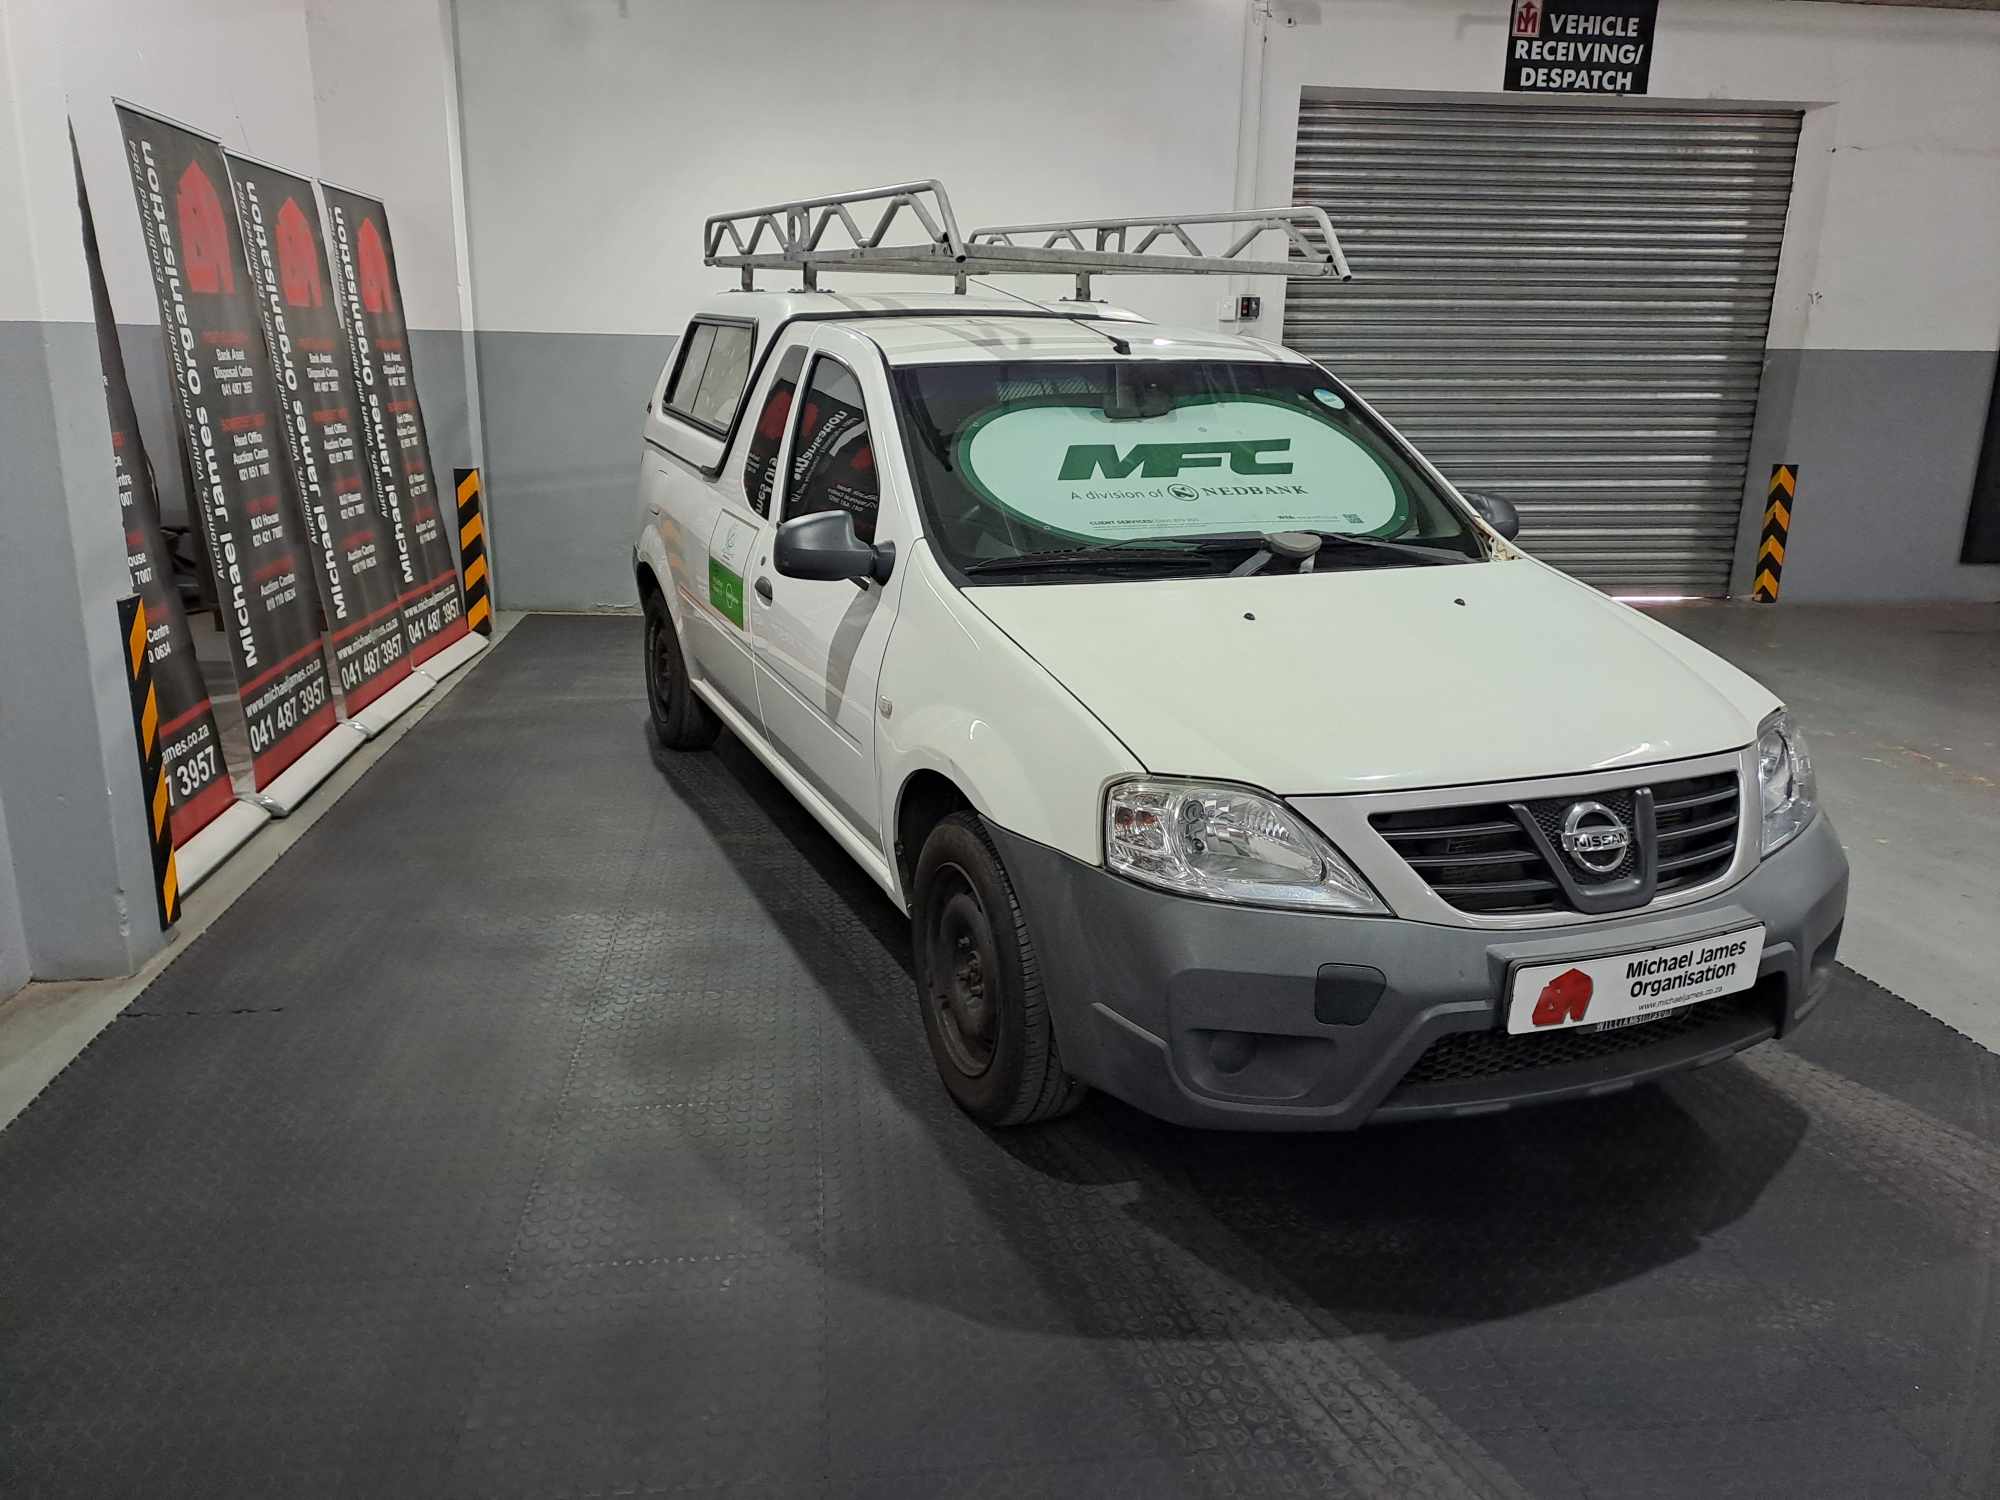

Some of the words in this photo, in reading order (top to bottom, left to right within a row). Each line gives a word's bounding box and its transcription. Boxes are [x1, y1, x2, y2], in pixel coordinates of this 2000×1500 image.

[1550, 14, 1640, 37] VEHICLE
[1514, 39, 1644, 65] RECEIVING/
[1520, 67, 1633, 91] DESPATCH
[128, 140, 144, 182] 1964
[138, 186, 164, 283] Established
[141, 140, 201, 395] Organisation
[246, 181, 298, 391] Organisation
[334, 206, 374, 386] Organisation
[162, 299, 184, 383] Appraisers
[178, 387, 192, 418] and
[277, 384, 289, 410] and
[187, 423, 204, 480] Valuers
[293, 400, 321, 497] James
[368, 393, 393, 478] James
[1057, 438, 1293, 481] MFC
[195, 406, 229, 522] James
[1071, 491, 1082, 500] A
[1086, 489, 1145, 500] division
[1149, 488, 1163, 499] of
[1200, 485, 1309, 497] NEDBANK
[202, 486, 225, 580] Auctioneers,
[385, 485, 415, 584] Michael
[313, 505, 348, 619] Michael
[219, 532, 258, 668] Michael
[408, 618, 426, 644] 041
[427, 610, 441, 633] 487
[442, 598, 460, 624] 3957
[147, 624, 170, 643] Centre
[154, 641, 172, 661] 0634
[341, 660, 362, 690] 041
[363, 646, 381, 677] 487
[381, 633, 402, 665] 3957
[251, 714, 276, 753] 041
[277, 697, 298, 732] 487
[300, 676, 325, 716] 3957
[177, 745, 216, 797] 3957
[1574, 833, 1627, 847] NISSAN
[1626, 950, 1693, 979] Michael
[1696, 941, 1746, 965] James
[1630, 962, 1736, 997] Organisation
[1638, 986, 1723, 1011] www.michaeljames.co.za
